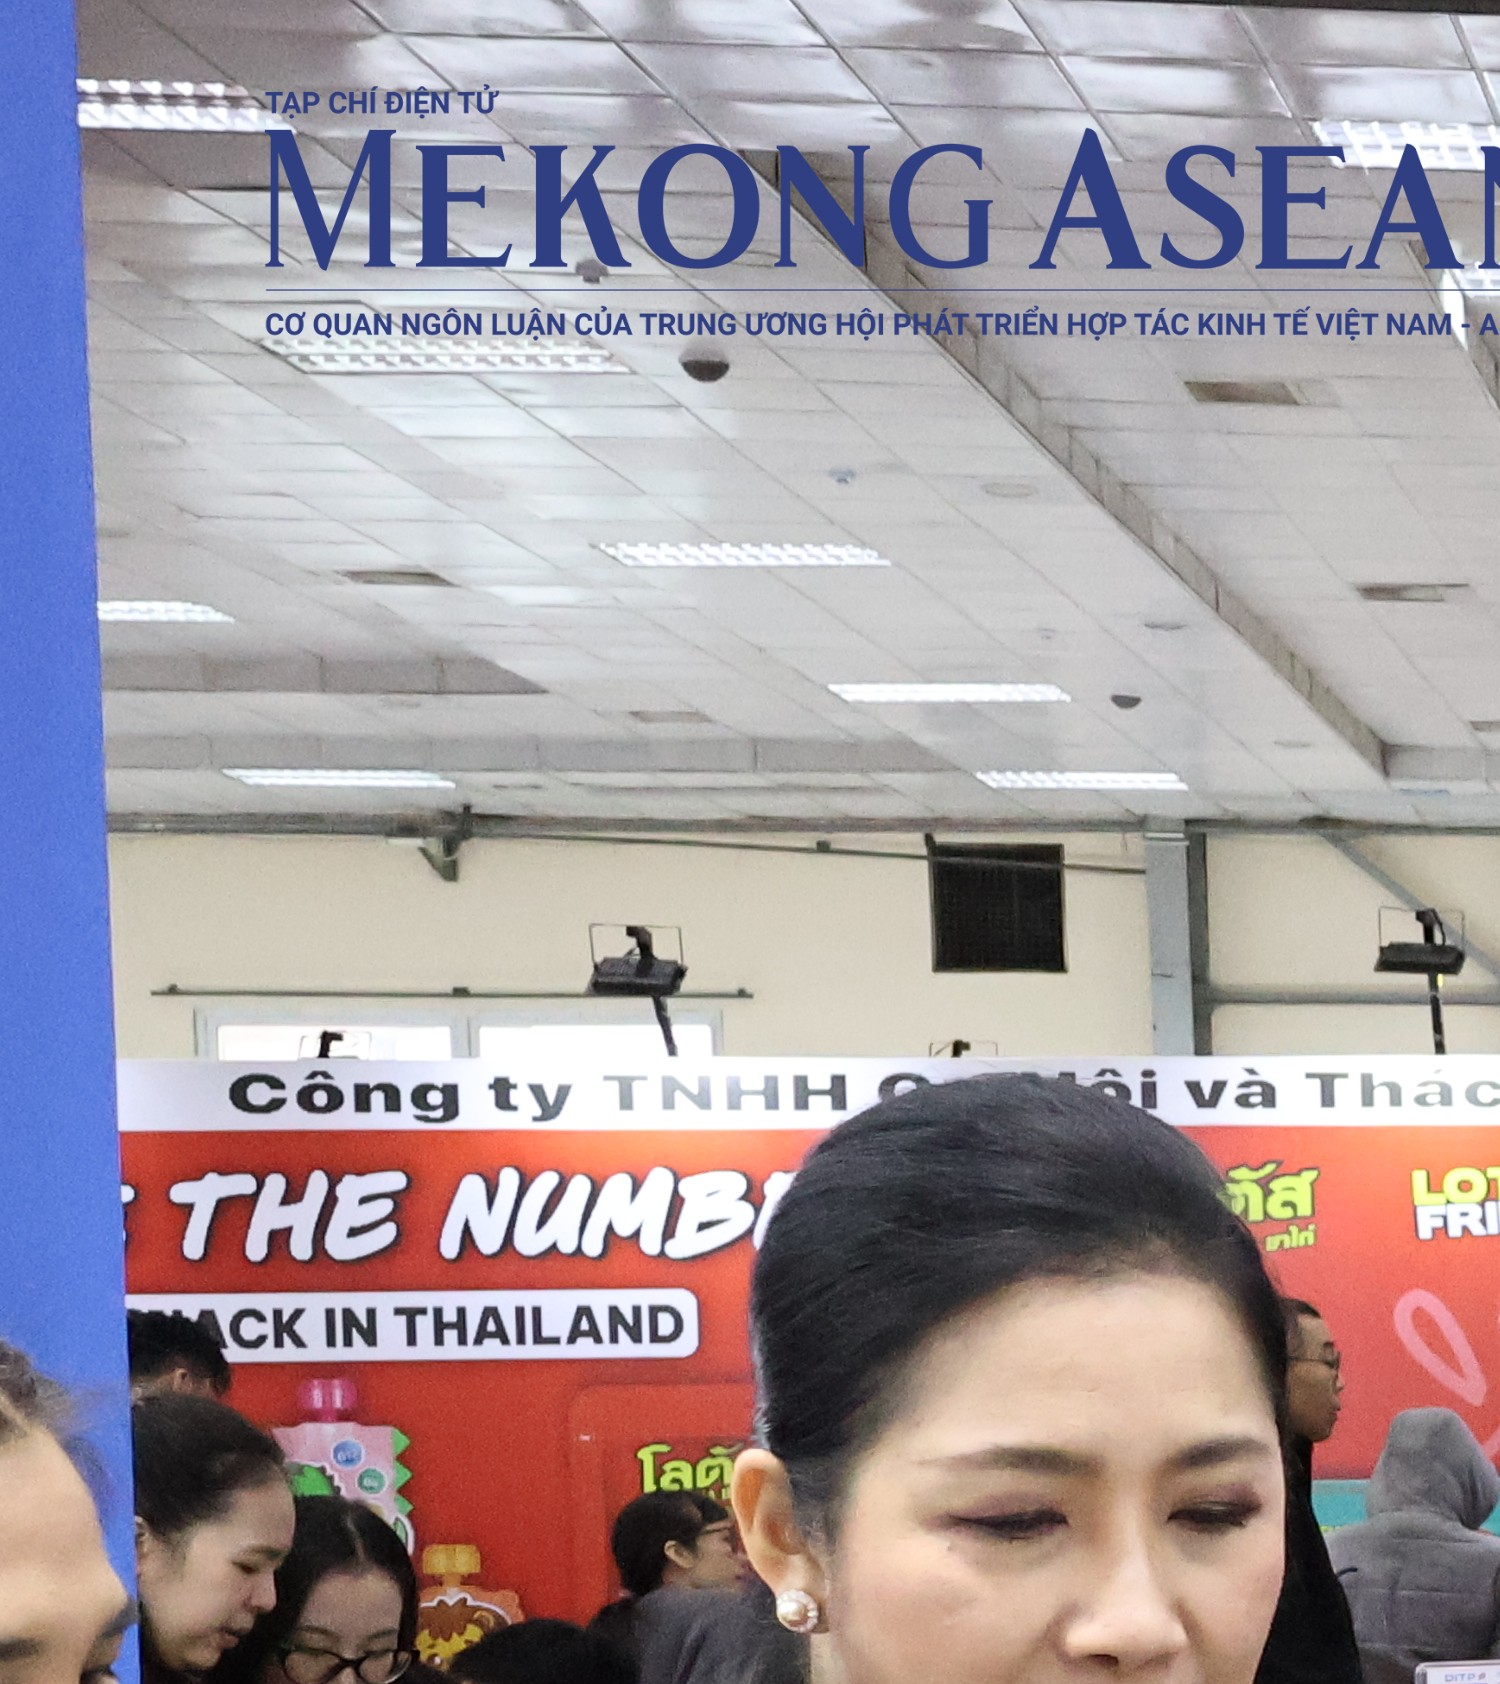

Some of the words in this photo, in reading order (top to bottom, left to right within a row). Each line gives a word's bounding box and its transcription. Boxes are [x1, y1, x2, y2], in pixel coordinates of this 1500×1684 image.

[229, 1072, 459, 1123] Công
[488, 1074, 572, 1122] ty
[602, 1074, 848, 1112] TNHH
[1185, 1068, 1279, 1109] và
[169, 1169, 409, 1263] THE
[439, 1166, 793, 1262] NUMB
[200, 1308, 308, 1349] ACK
[324, 1308, 378, 1349] IN
[394, 1304, 686, 1348] THAILAND
